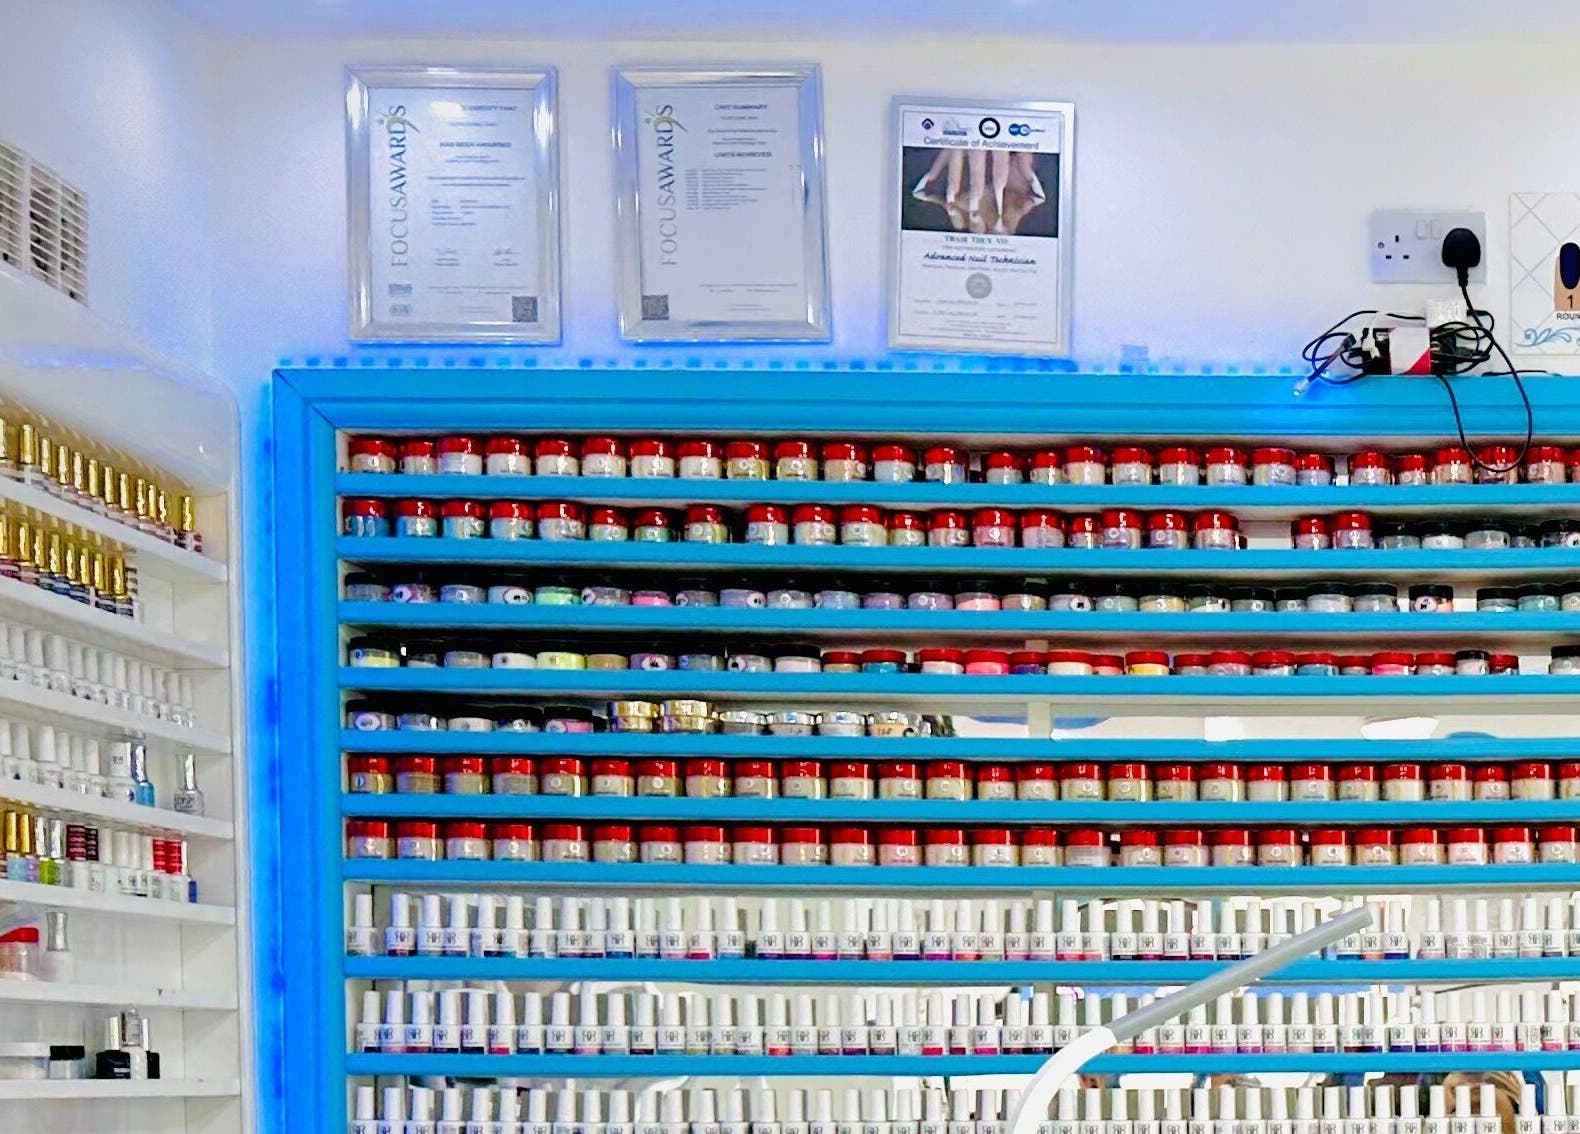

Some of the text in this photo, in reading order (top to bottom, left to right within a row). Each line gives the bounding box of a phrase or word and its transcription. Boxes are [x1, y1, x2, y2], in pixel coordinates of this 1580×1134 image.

[923, 136, 1040, 150] Certificate of Achievement
[388, 104, 409, 267] FOCUSAWARDS
[657, 103, 678, 266] FOCUSAWARDS
[923, 251, 1038, 265] Advanced Nail Technician
[1567, 294, 1574, 309] 1
